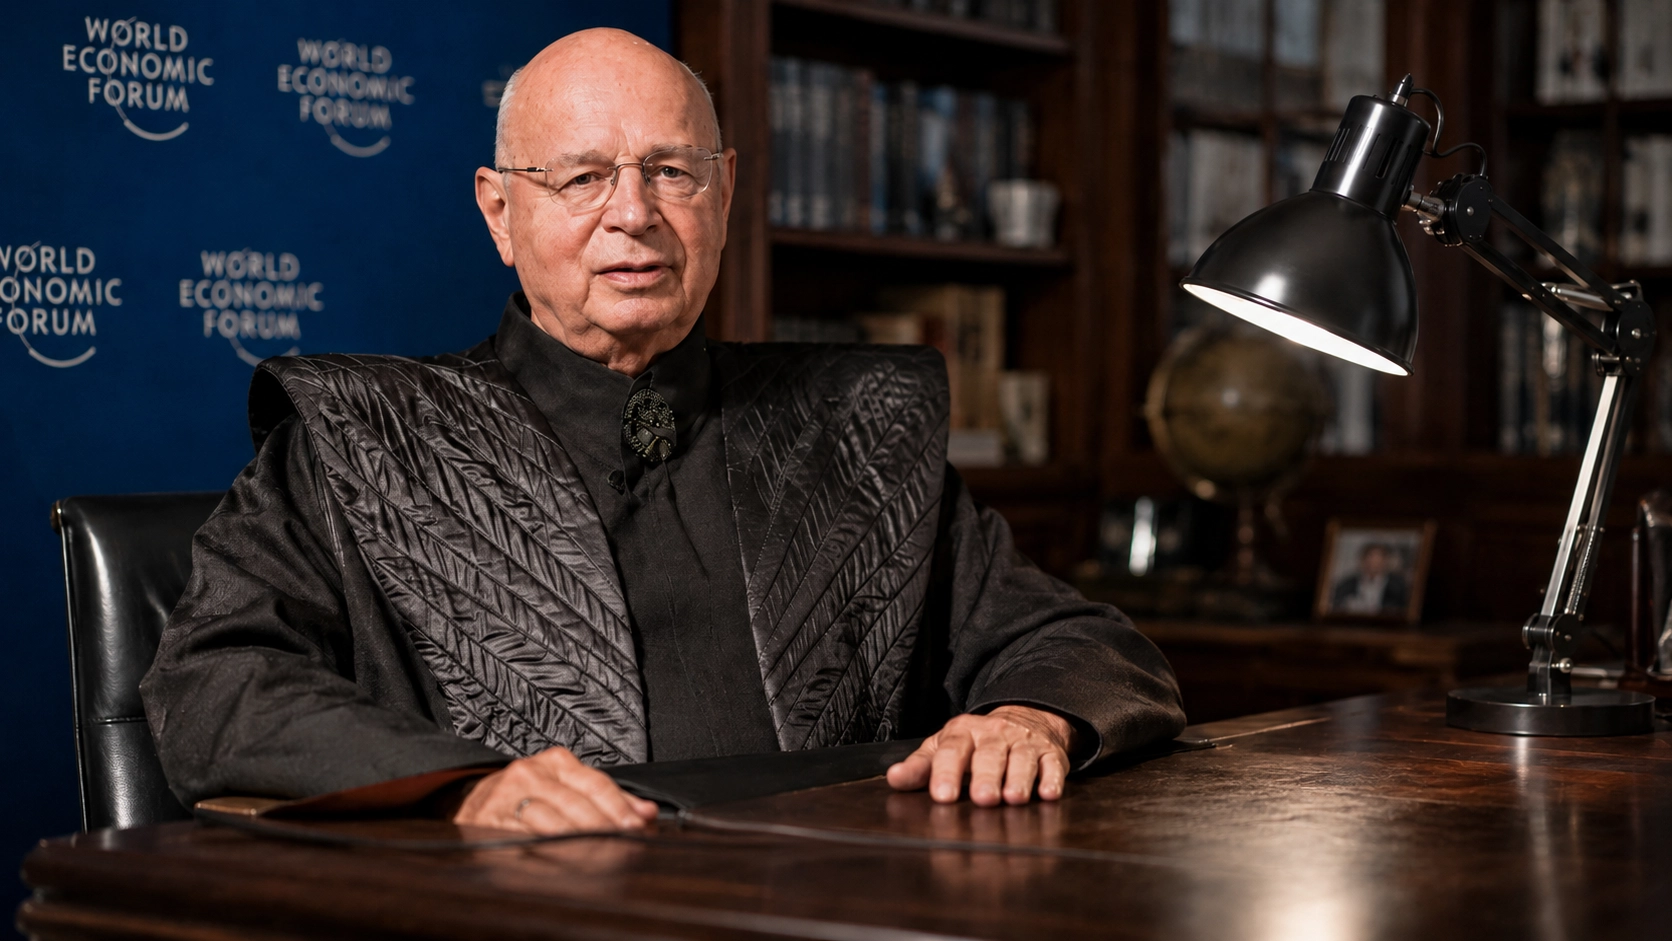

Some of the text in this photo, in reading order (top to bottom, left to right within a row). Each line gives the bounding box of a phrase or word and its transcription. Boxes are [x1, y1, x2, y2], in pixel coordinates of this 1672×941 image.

[85, 17, 187, 52] WORLD
[64, 45, 213, 85] ECONOMIC
[299, 40, 391, 73] WORLD
[89, 79, 189, 112] FORUM
[278, 65, 414, 104] ECONOMIC
[300, 97, 391, 129] FORUM
[201, 252, 300, 280] WORLD
[0, 276, 122, 305] ONOMIC
[180, 281, 324, 311] ECONOMIC
[0, 307, 95, 335] ORUM
[204, 312, 301, 339] FORUM
